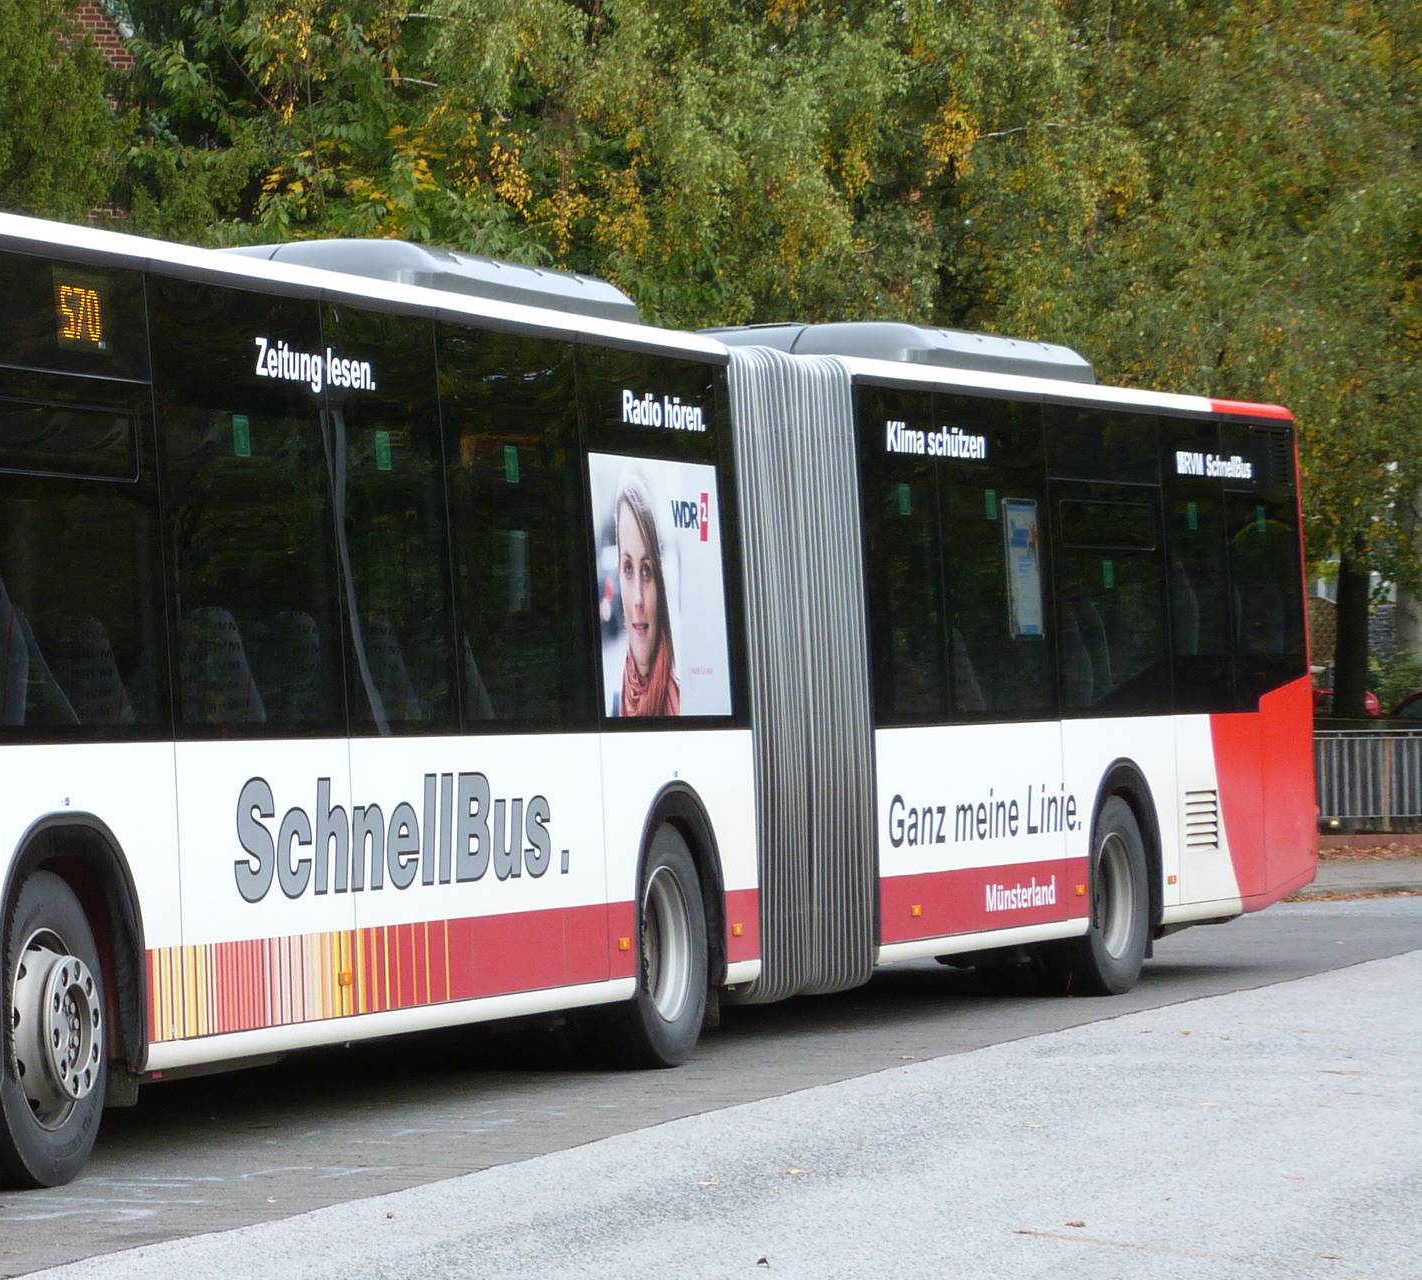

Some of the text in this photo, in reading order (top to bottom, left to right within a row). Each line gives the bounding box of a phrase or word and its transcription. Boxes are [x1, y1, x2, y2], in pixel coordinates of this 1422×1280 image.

[60, 285, 101, 341] S70
[255, 336, 376, 393] Zeitung lesen.
[623, 389, 706, 432] Radio hören.
[886, 420, 986, 459] Klima schützen
[1185, 452, 1252, 479] RVM SchnellBus
[671, 500, 699, 529] WDR
[888, 782, 1082, 848] Ganz meine Linie.
[985, 874, 1056, 912] Münsterland
